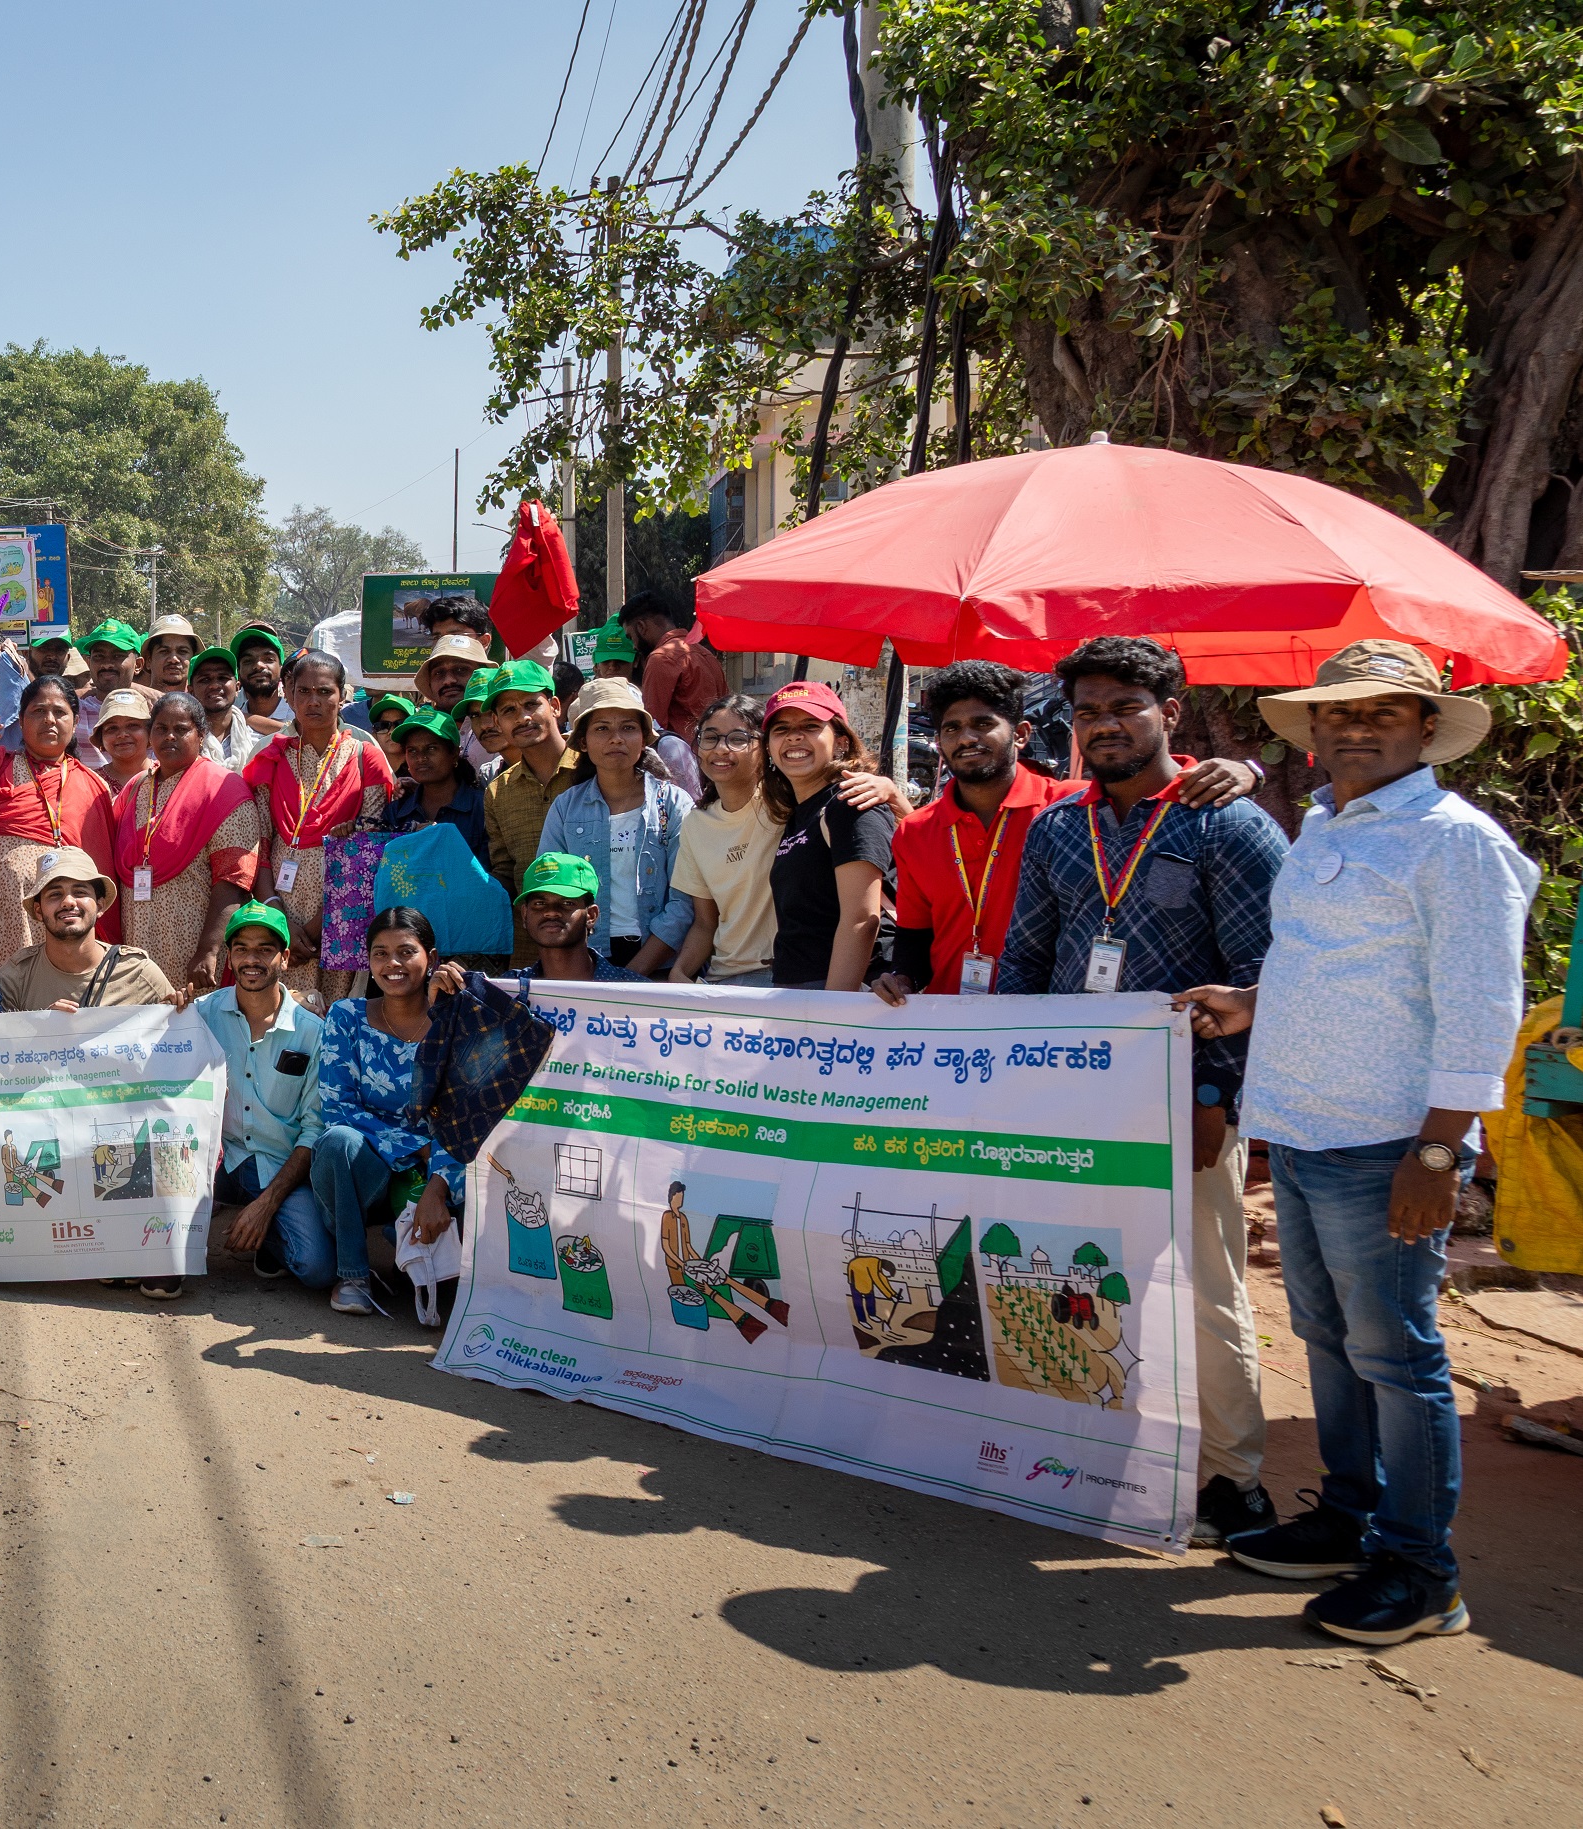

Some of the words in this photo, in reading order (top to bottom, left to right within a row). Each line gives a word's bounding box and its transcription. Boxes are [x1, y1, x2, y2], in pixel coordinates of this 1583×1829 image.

[15, 1047, 86, 1069] ಸಹಭಾಗಿತ್ವದಲ್ಲಿ
[90, 1044, 108, 1058] ಘನ
[114, 1043, 146, 1061] ತ್ಯಾಜ್ಯ
[586, 1012, 638, 1048] ಮತ್ತು
[649, 1018, 713, 1057] ರೈತರ
[723, 1027, 876, 1076] ಸಹಭಾಗಿತ್ವದಲ್ಲಿ
[886, 1041, 926, 1071] ಘನ
[934, 1047, 996, 1085] ತ್ಯಾಜ್ಯ
[1006, 1040, 1113, 1071] ನಿರ್ವಹಣೆ
[0, 1077, 13, 1086] for
[15, 1075, 36, 1085] Solid
[37, 1073, 64, 1085] Waste
[66, 1069, 121, 1084] Management
[582, 1062, 680, 1091] Partnership
[685, 1073, 711, 1093] for
[715, 1078, 759, 1100] Solid
[763, 1084, 817, 1106] Waste
[821, 1090, 929, 1112] Management
[563, 1099, 612, 1122] ಸಂಗ್ರಹಿಸಿ
[670, 1113, 749, 1141] ಪ್ರತ್ಯೇಕವಾಗಿ
[755, 1125, 787, 1143] ನೀಡಿ
[853, 1134, 877, 1152] ಹಸಿ
[884, 1136, 908, 1154] ಕಸ
[913, 1137, 965, 1165] ರೈತರಿಗೆ
[970, 1140, 1094, 1173] ಗೊಬ್ಬರವಾಗುತ್ತದೆ
[51, 1221, 95, 1239] iihs
[141, 1216, 175, 1246] Godrej
[501, 1336, 538, 1357] clean
[540, 1349, 577, 1367] clean
[980, 1440, 1007, 1461] iihs
[1026, 1456, 1080, 1489] Godrej
[1085, 1473, 1147, 1495] PROPERTIES
